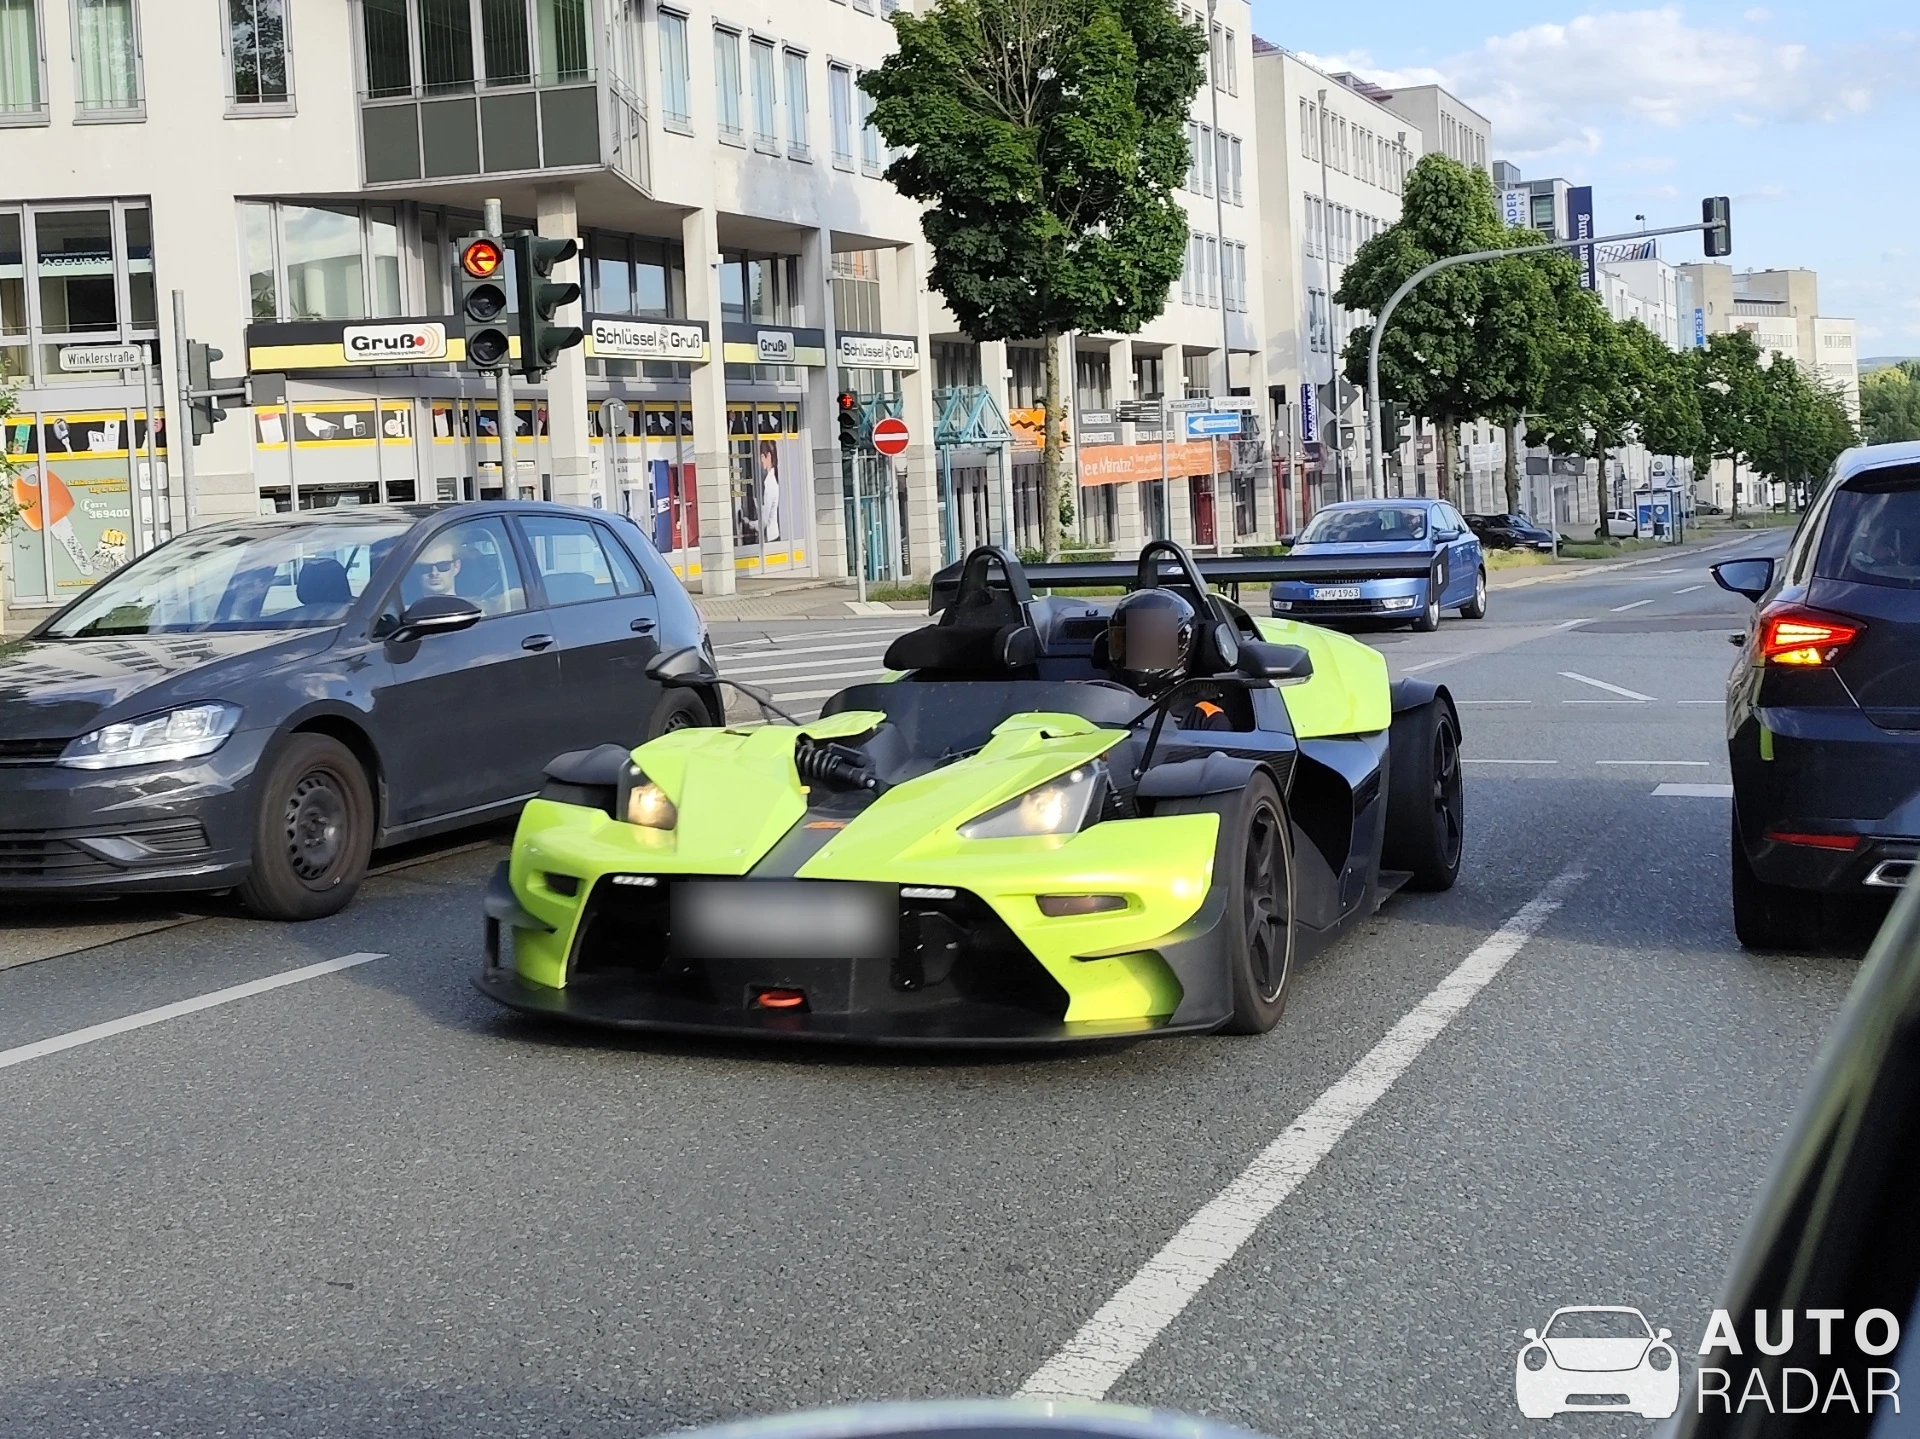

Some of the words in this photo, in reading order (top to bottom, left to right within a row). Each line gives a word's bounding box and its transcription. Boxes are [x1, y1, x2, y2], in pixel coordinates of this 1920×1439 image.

[1506, 193, 1517, 228] ÄDER
[350, 333, 416, 351] Gruß
[595, 327, 657, 347] Schlüssel
[670, 332, 700, 348] Gruß
[760, 339, 784, 353] Gruß
[843, 341, 884, 359] Schlüssel
[892, 345, 913, 359] Gruß
[67, 350, 135, 365] Winklerstraße
[89, 509, 131, 519] 369400
[1338, 589, 1359, 598] 1963
